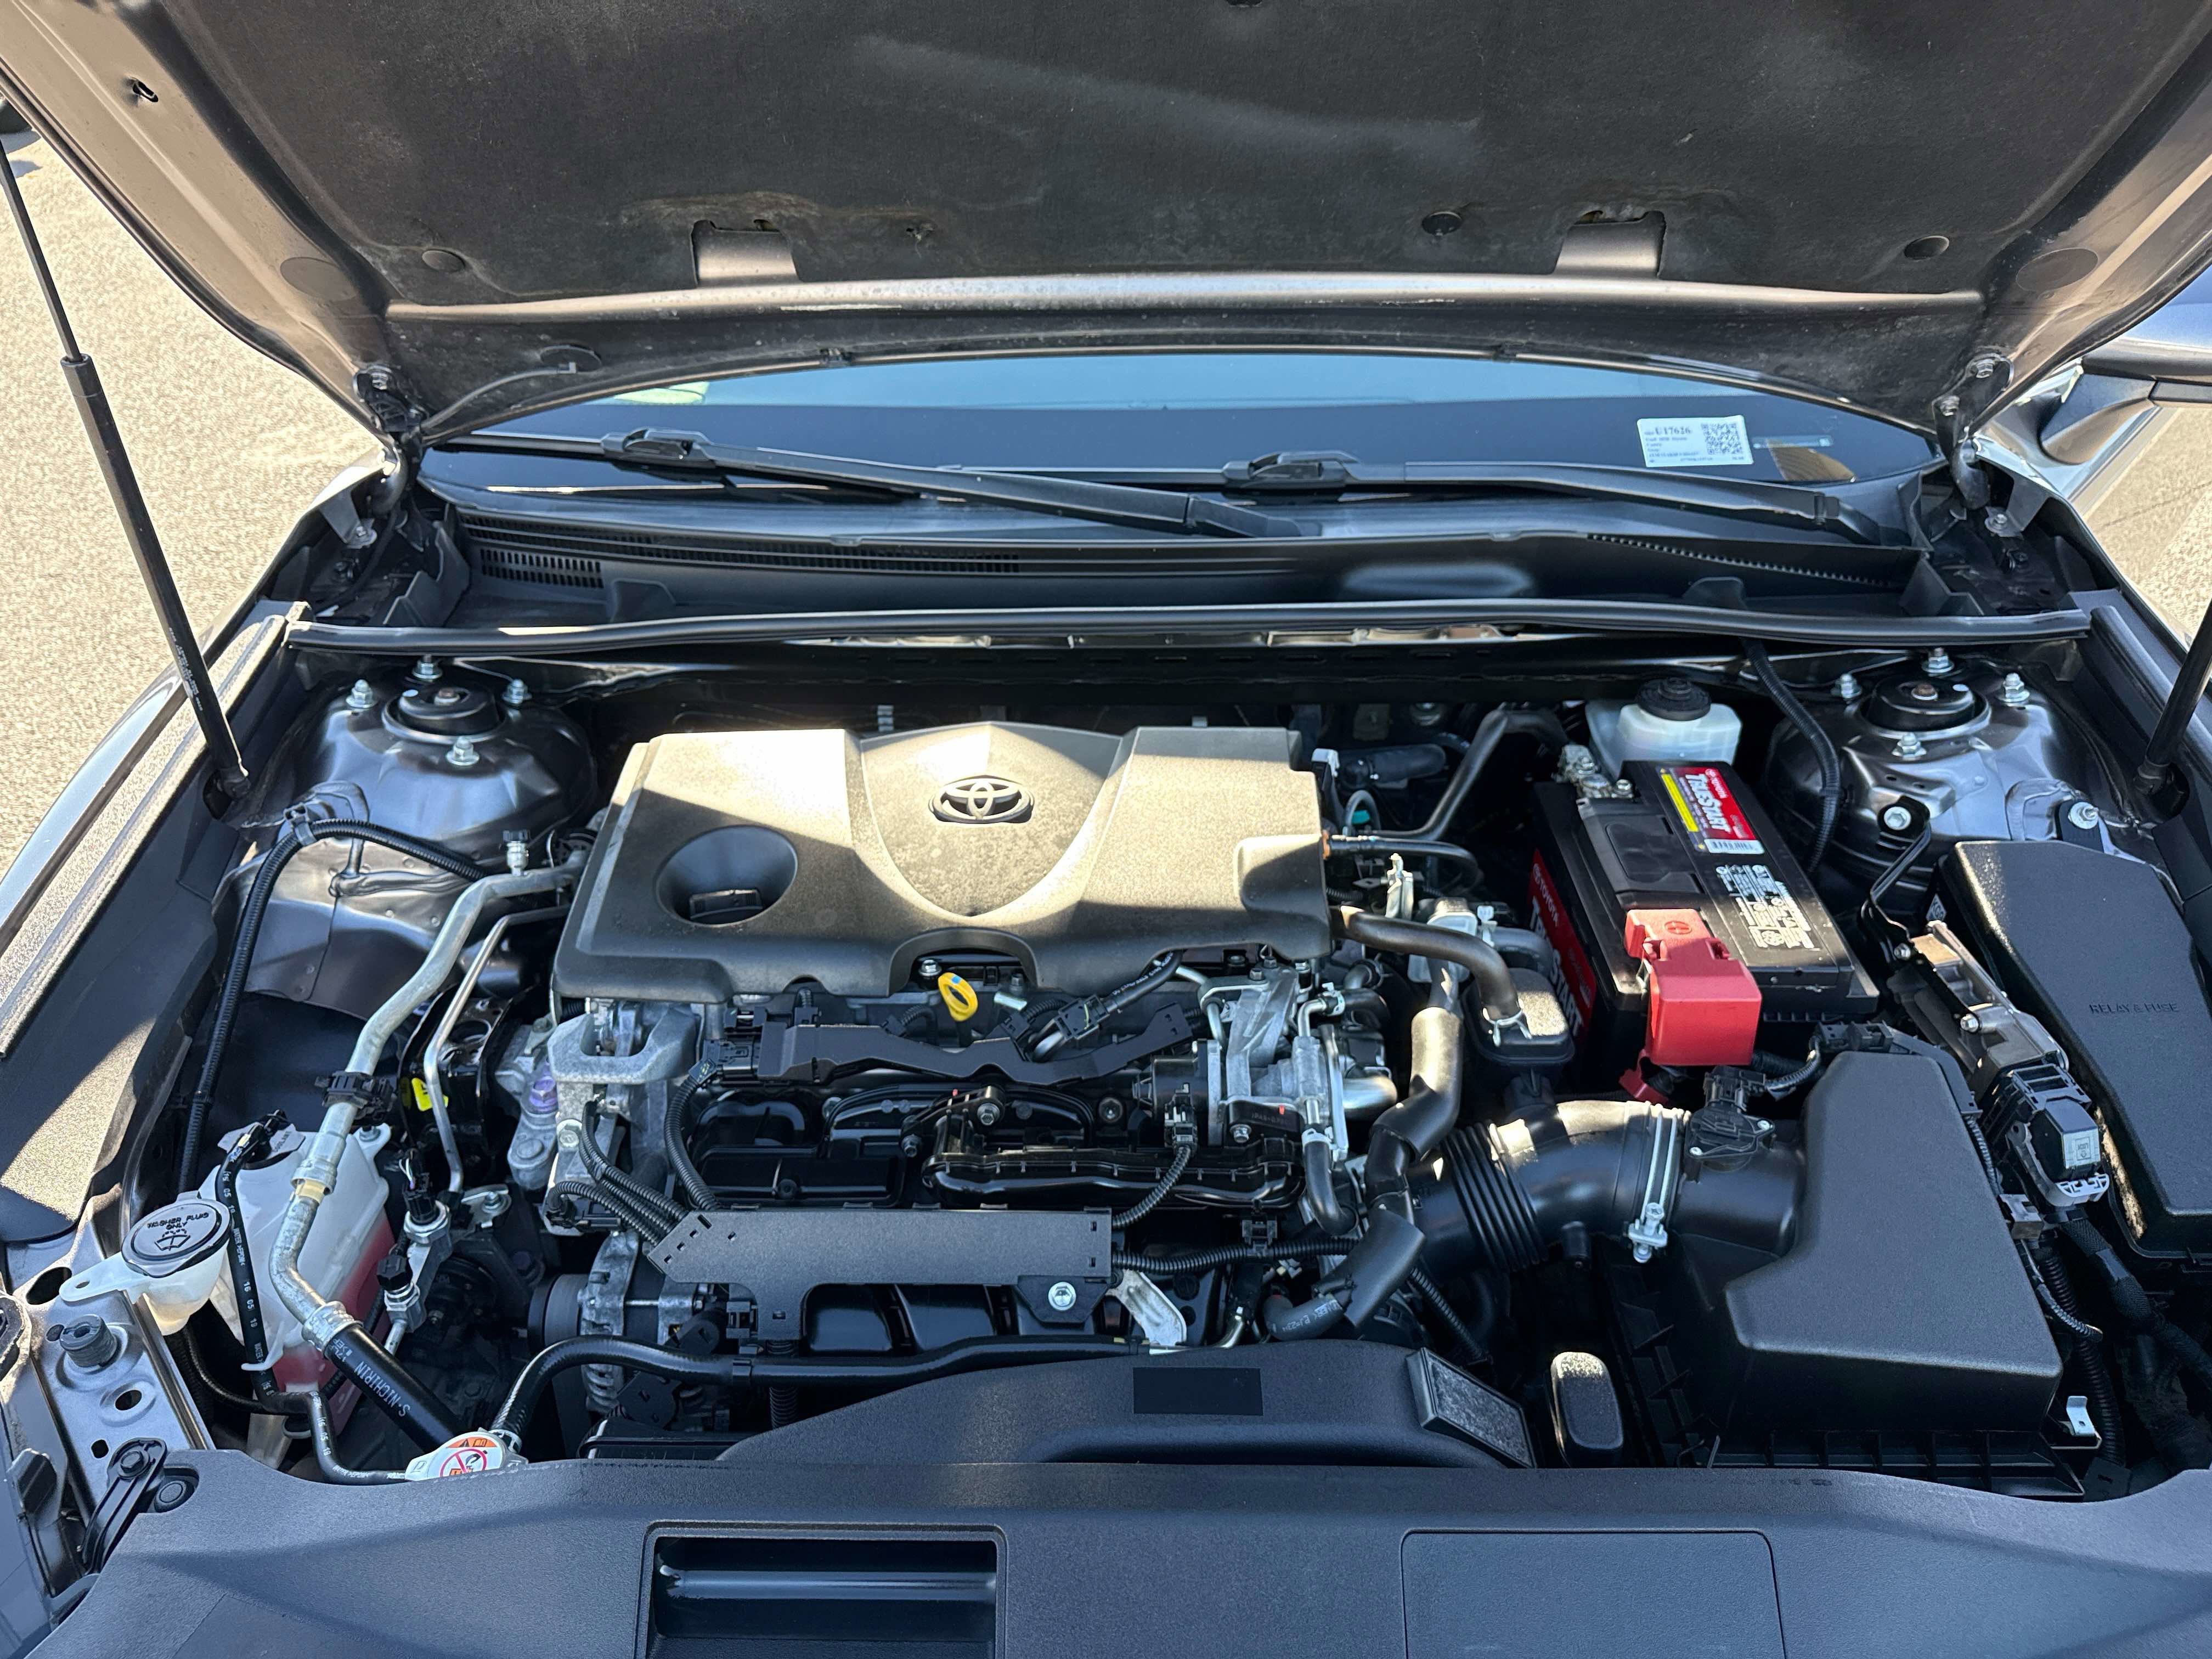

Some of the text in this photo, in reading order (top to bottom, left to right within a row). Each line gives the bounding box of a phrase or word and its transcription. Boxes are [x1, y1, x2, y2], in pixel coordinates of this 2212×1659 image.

[1539, 883, 1559, 927] TOYOTA
[2089, 1003, 2130, 1014] RELAY
[2144, 1003, 2179, 1014] FUSE
[146, 1212, 210, 1229] WASHER FLUID
[166, 1222, 188, 1230] ONLY
